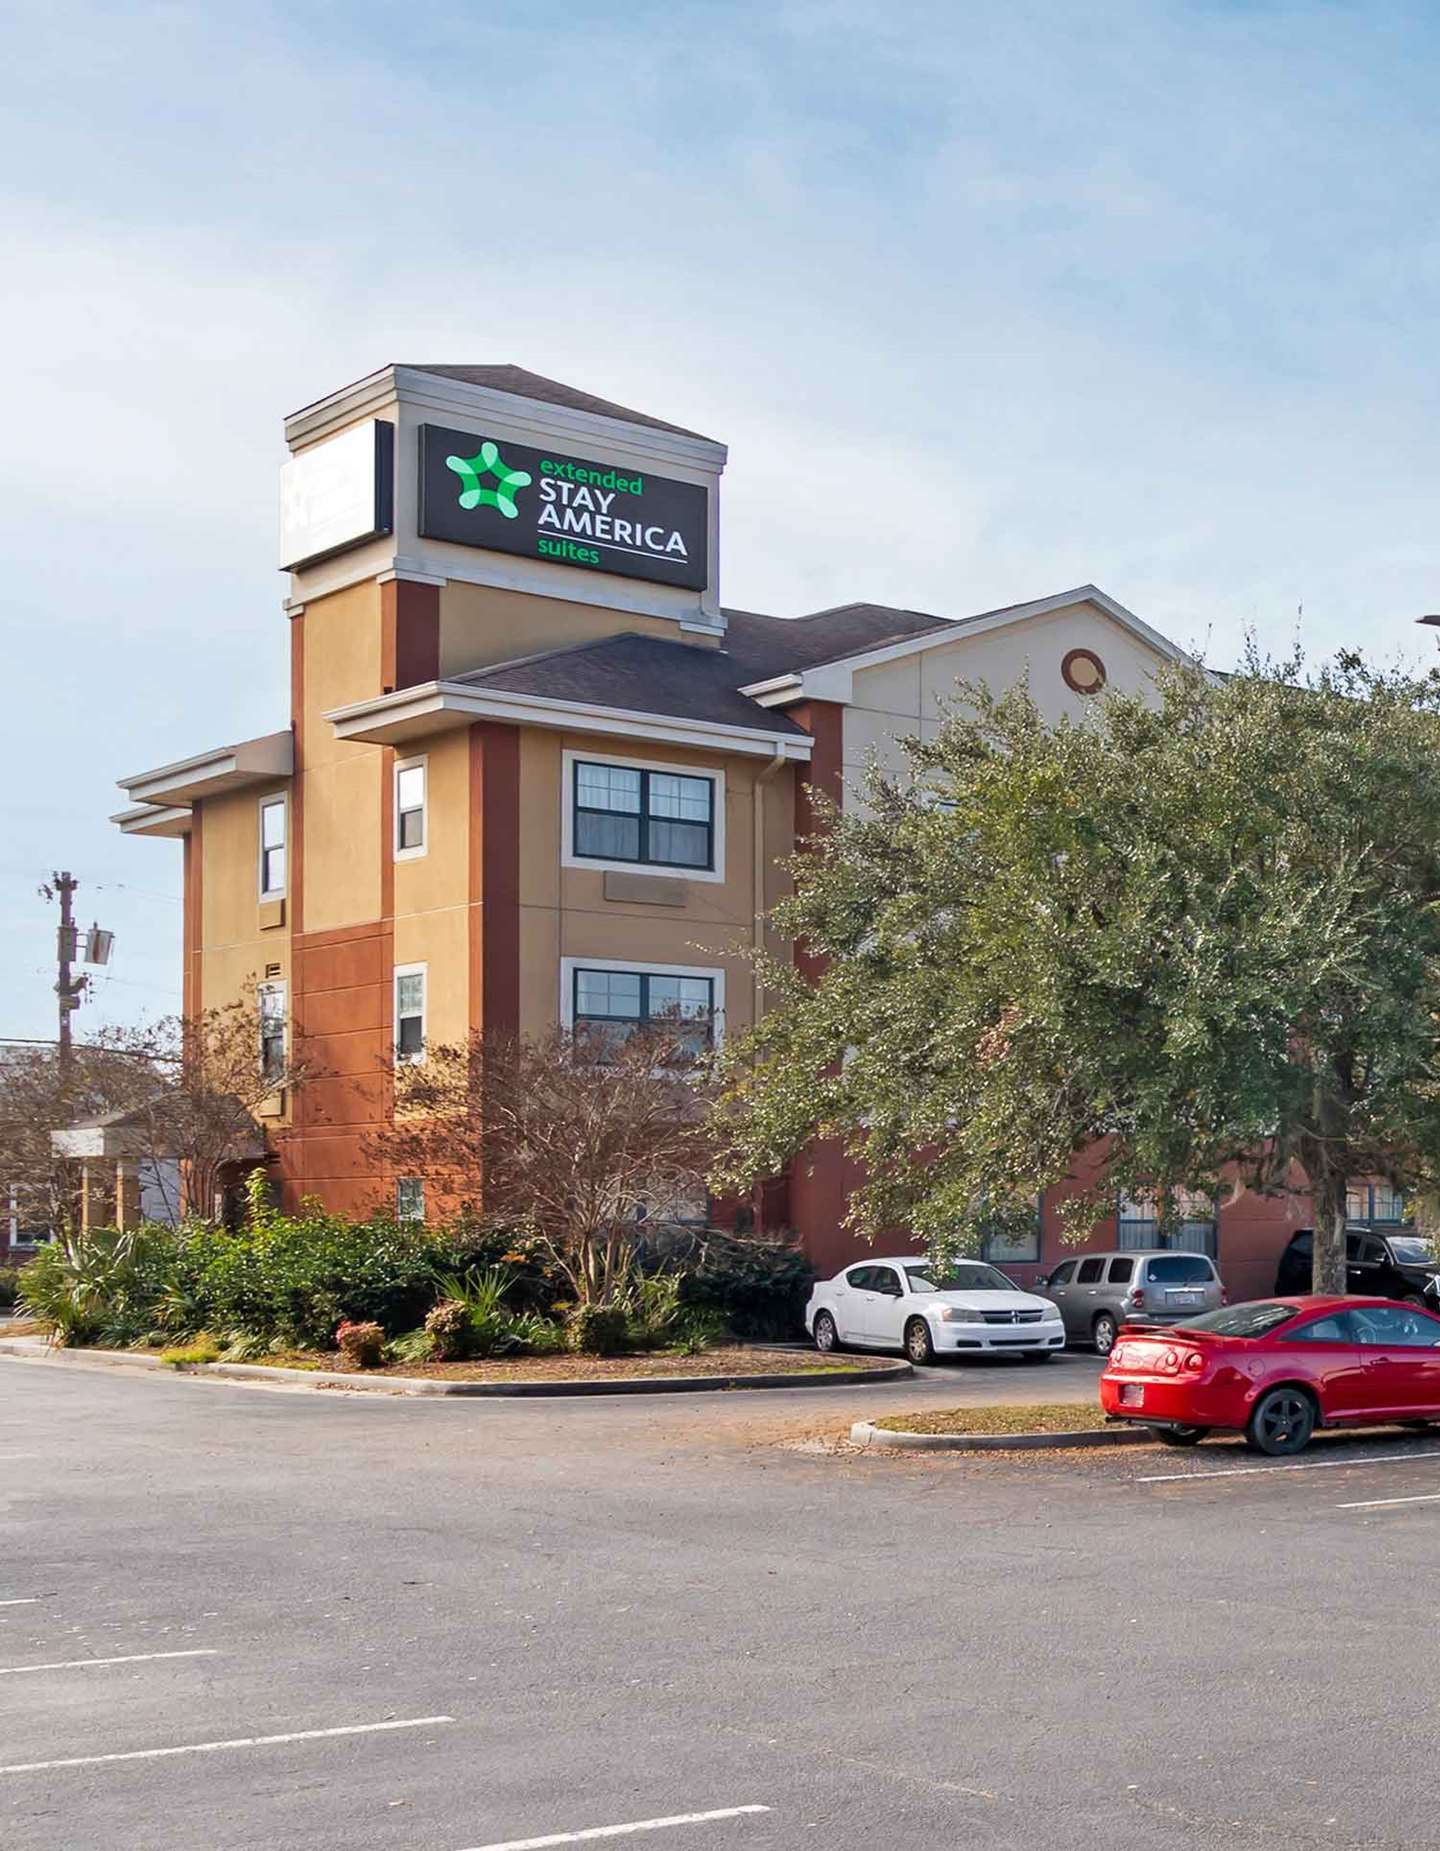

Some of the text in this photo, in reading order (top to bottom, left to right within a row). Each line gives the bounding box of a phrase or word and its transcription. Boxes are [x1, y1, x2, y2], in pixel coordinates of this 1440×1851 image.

[539, 458, 644, 496] extended
[539, 477, 616, 515] STAY
[537, 503, 689, 556] AMERICA
[538, 538, 600, 565] suites
